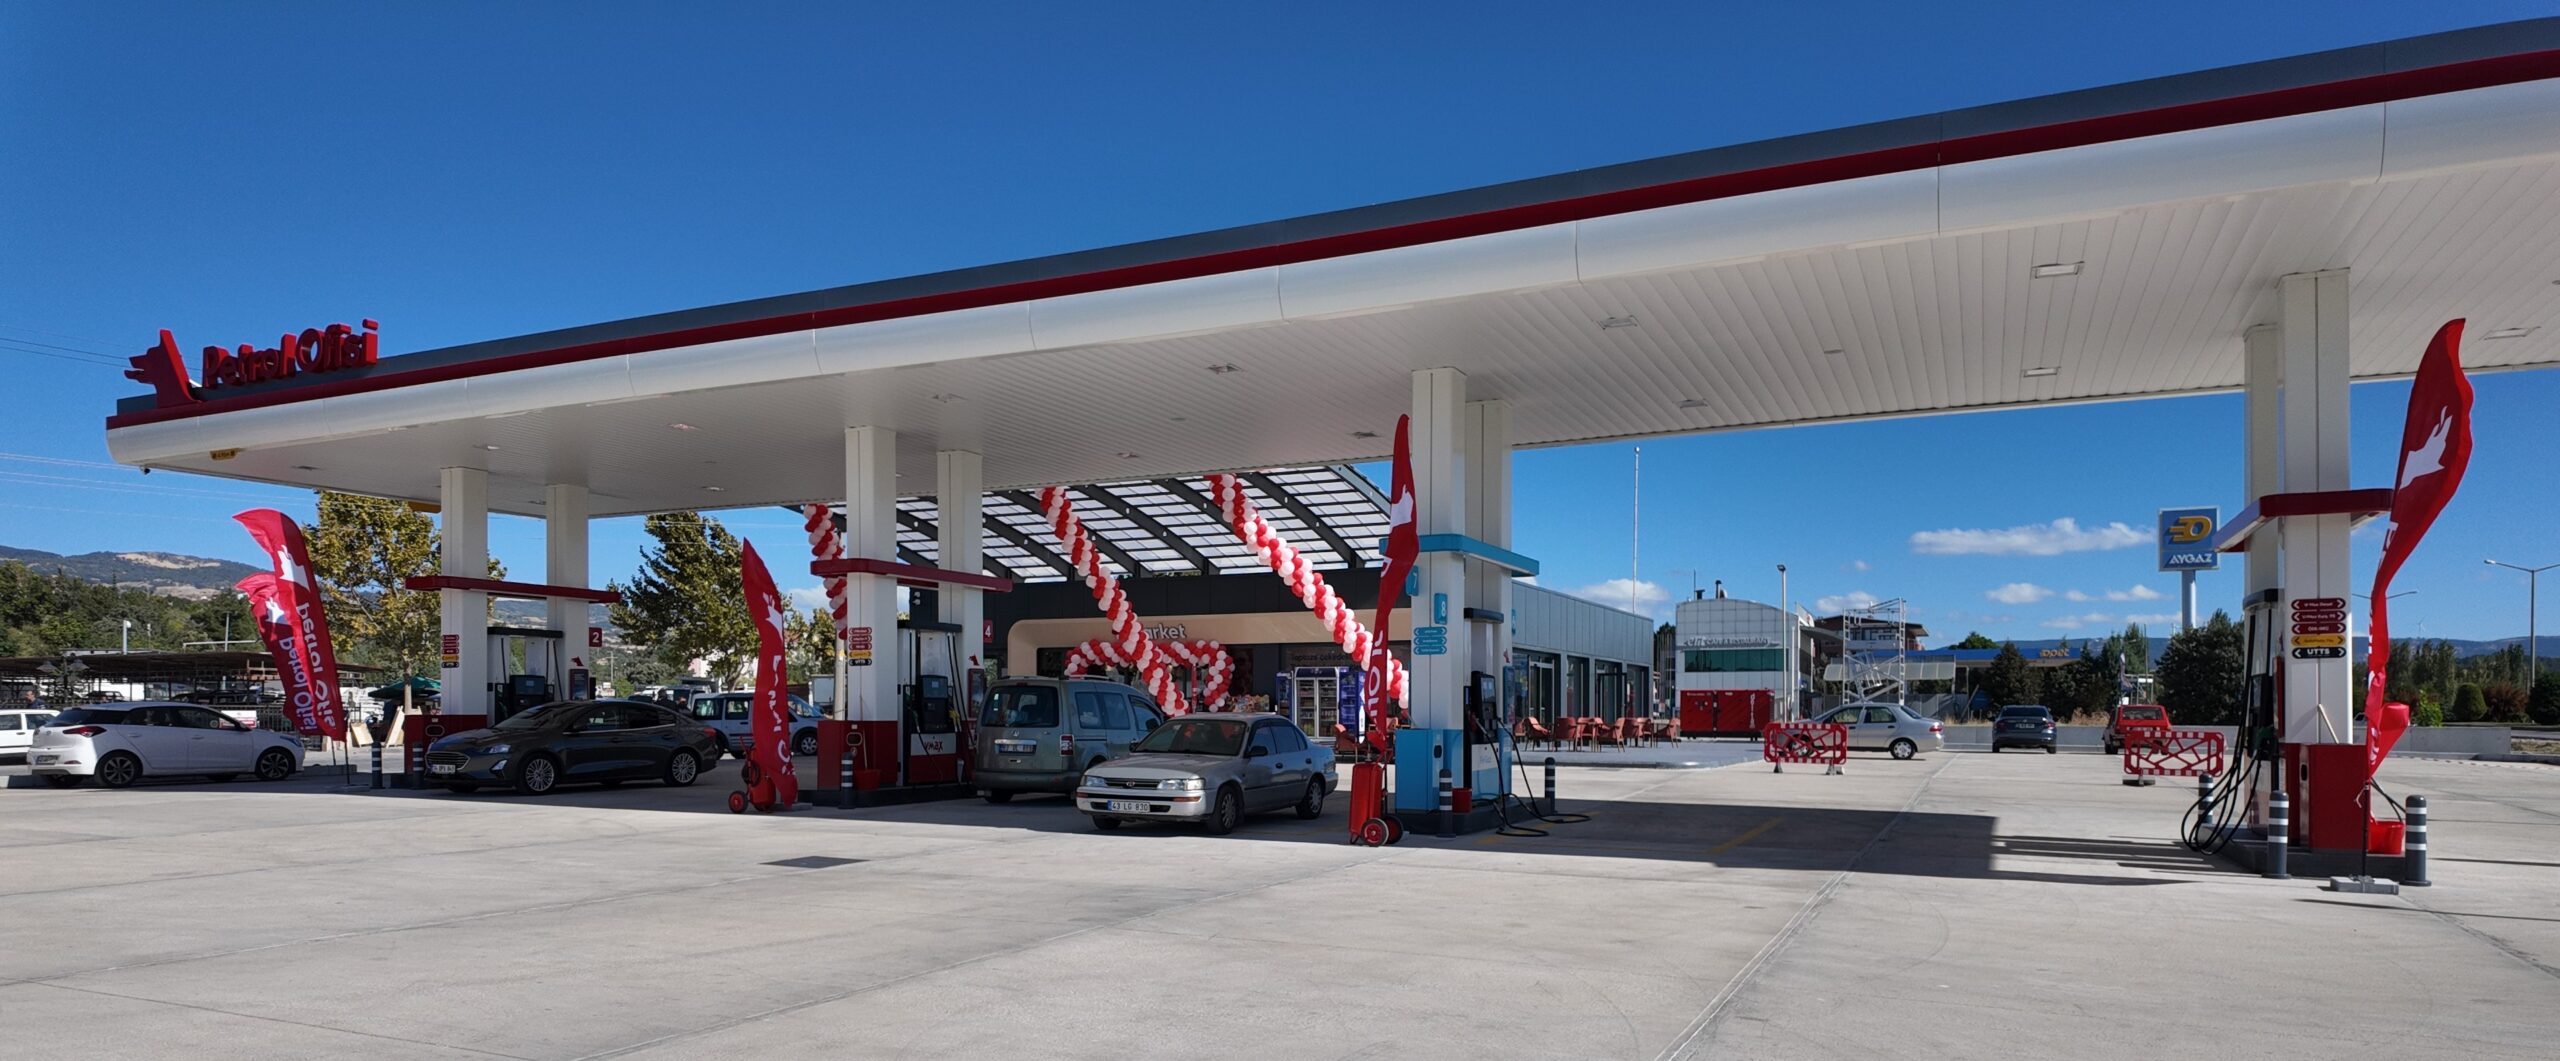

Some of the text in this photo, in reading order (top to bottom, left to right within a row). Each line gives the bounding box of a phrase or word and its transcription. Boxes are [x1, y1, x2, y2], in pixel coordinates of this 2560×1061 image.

[203, 319, 379, 389] Petrol Ofisi
[2169, 553, 2213, 564] AYGAZ
[1441, 601, 1446, 617] 8
[985, 626, 991, 637] 4
[1145, 623, 1186, 639] arket
[592, 632, 599, 643] 2
[1112, 802, 1149, 811] 43 LG 830
